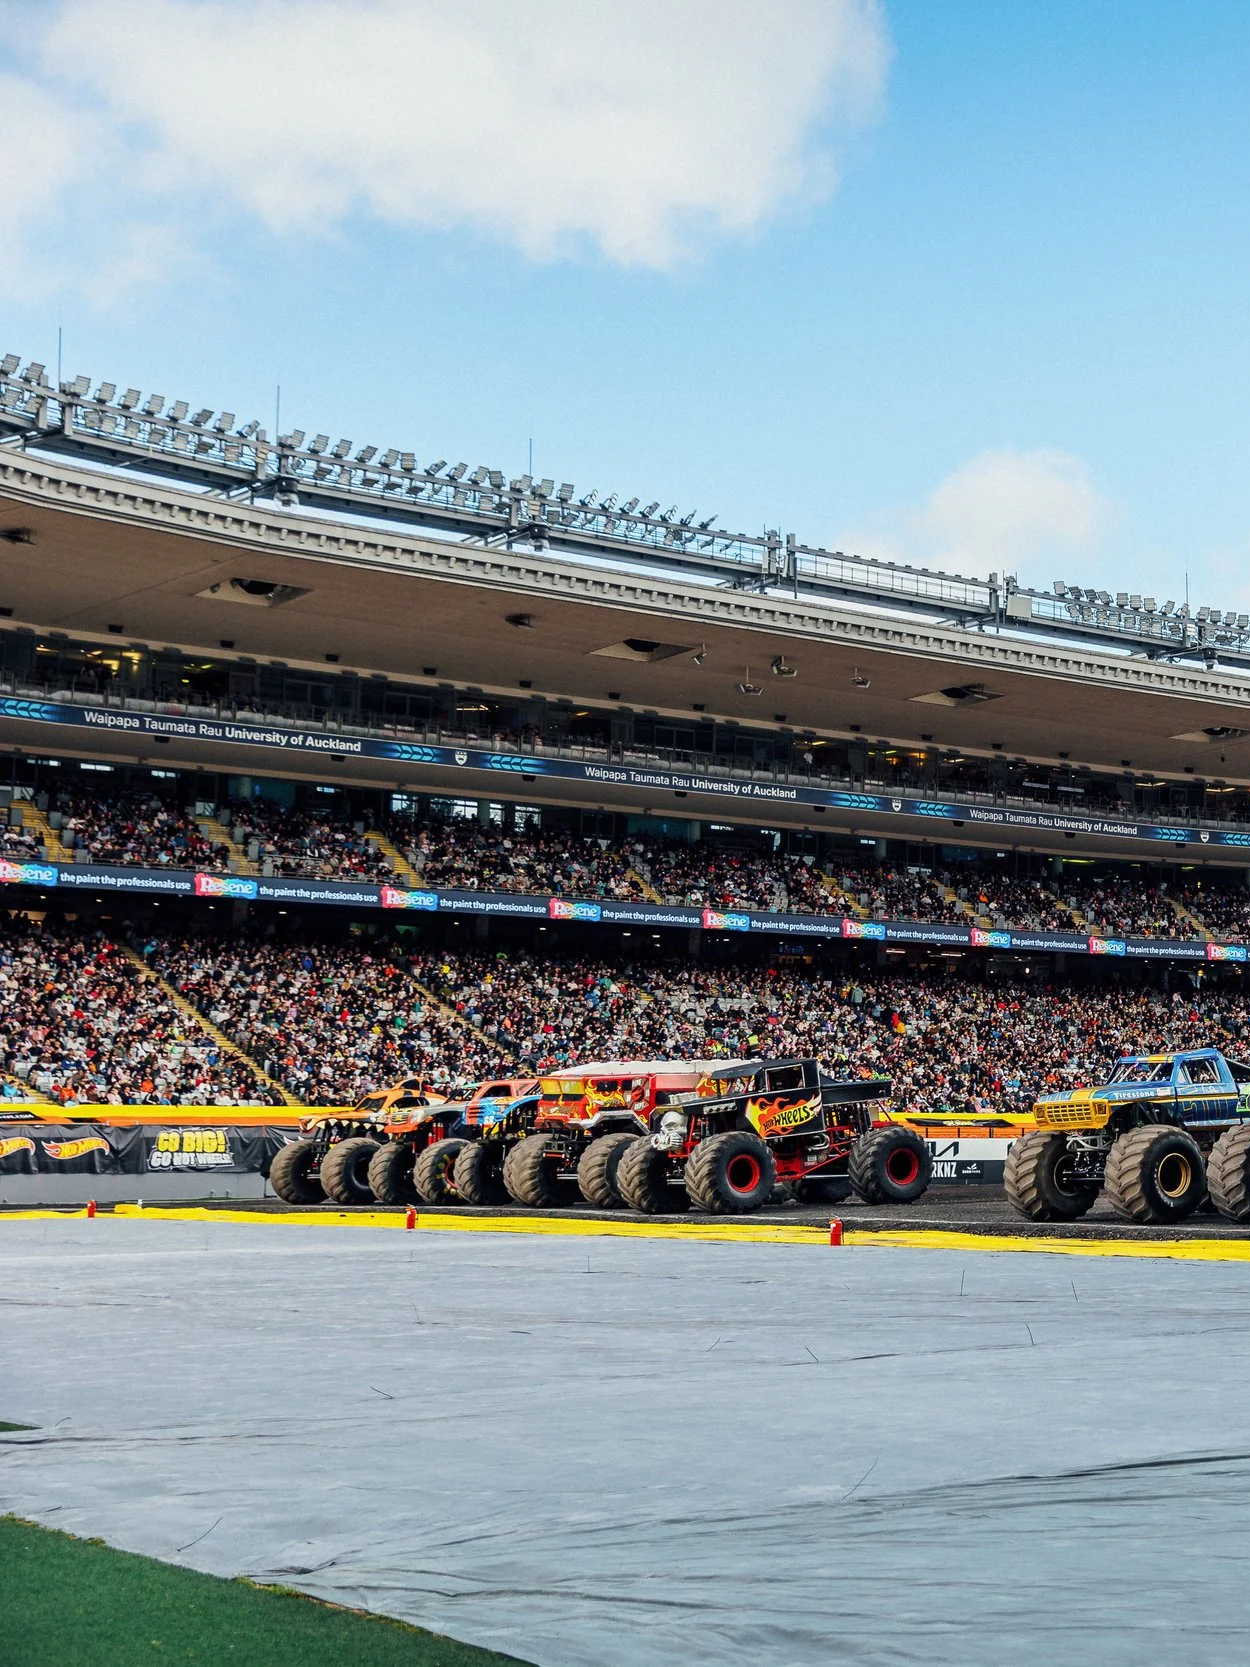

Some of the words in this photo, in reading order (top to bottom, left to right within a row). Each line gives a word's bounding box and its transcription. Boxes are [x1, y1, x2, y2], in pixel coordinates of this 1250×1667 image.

[84, 711, 140, 728] Waipapa
[143, 717, 196, 734] Taumata
[199, 723, 222, 737] Rau
[225, 727, 287, 745] University
[290, 734, 303, 746] of
[306, 736, 361, 751] Auckland
[585, 767, 626, 781] Waipapa
[629, 771, 669, 785] Taumata
[672, 776, 689, 788] Rau
[692, 778, 739, 794] University
[741, 785, 752, 794] of
[754, 786, 796, 799] Auckland
[970, 809, 1003, 821] Waipapa
[1005, 813, 1037, 825] Taumata
[1038, 816, 1053, 826] Rau
[1054, 818, 1092, 832] University
[1094, 823, 1102, 832] of
[1103, 823, 1137, 835] Auckland
[0, 864, 53, 881] Resene
[60, 872, 75, 882] the
[77, 873, 100, 886] paint
[101, 875, 116, 885] the
[117, 876, 174, 890] professionals
[175, 882, 191, 890] use
[201, 877, 253, 894] Resene
[259, 886, 274, 895] the
[275, 888, 296, 899] paint
[297, 889, 310, 898] the
[311, 890, 363, 902] professionals
[364, 894, 378, 903] use
[386, 891, 434, 907] Resene
[440, 898, 452, 908] the
[453, 900, 473, 910] paint
[473, 901, 485, 910] the
[486, 901, 533, 913] professionals
[534, 906, 546, 914] use
[554, 901, 598, 917] Resene
[602, 910, 614, 919] the
[614, 911, 633, 922] paint
[633, 912, 644, 921] the
[645, 912, 688, 924] professionals
[688, 916, 700, 925] use
[706, 912, 747, 927] Resene
[751, 920, 762, 929] the
[762, 922, 779, 932] paint
[779, 922, 789, 931] the
[789, 922, 829, 933] professionals
[829, 926, 840, 934] use
[846, 922, 882, 936] Resene
[887, 930, 897, 938] the
[897, 930, 913, 941] paint
[914, 931, 923, 940] the
[923, 931, 959, 942] professionals
[975, 931, 1009, 945] Resene
[1021, 939, 1035, 949] paint
[1035, 940, 1044, 948] the
[1044, 940, 1078, 950] professionals
[1078, 943, 1087, 951] use
[1092, 939, 1124, 953] Resene
[1127, 946, 1135, 954] the
[1135, 947, 1149, 956] paint
[1149, 946, 1158, 955] the
[1158, 947, 1195, 957] professionals
[1210, 946, 1244, 959] Resene
[1113, 1091, 1155, 1099] Firestone
[763, 1118, 775, 1130] HOT
[774, 1106, 811, 1126] WHEELS
[157, 1131, 180, 1152] GO
[182, 1130, 226, 1153] BIG!
[151, 1151, 172, 1167] GO
[173, 1152, 196, 1166] HOT
